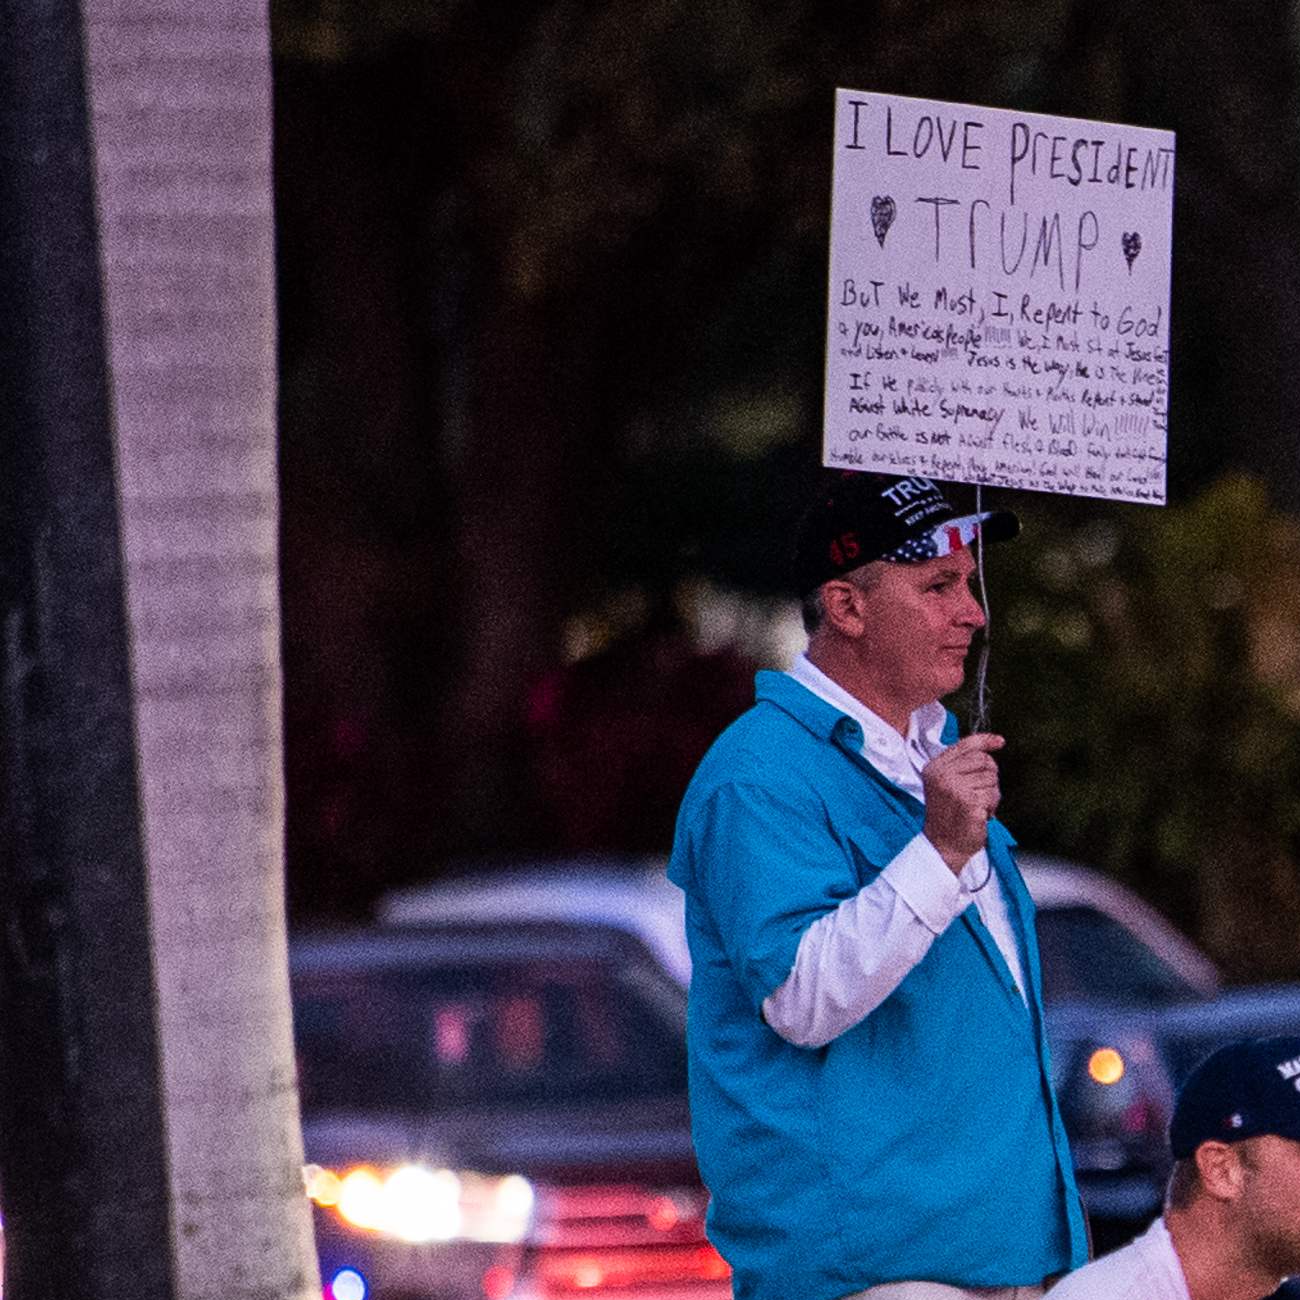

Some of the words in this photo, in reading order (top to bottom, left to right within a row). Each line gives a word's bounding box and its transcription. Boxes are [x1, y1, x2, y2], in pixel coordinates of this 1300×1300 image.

[845, 101, 868, 149] I
[886, 106, 983, 170] LOVE
[898, 282, 921, 308] We
[1021, 294, 1083, 331] Repent
[1091, 301, 1110, 330] to
[1117, 306, 1161, 337] God
[881, 476, 944, 506] TRU
